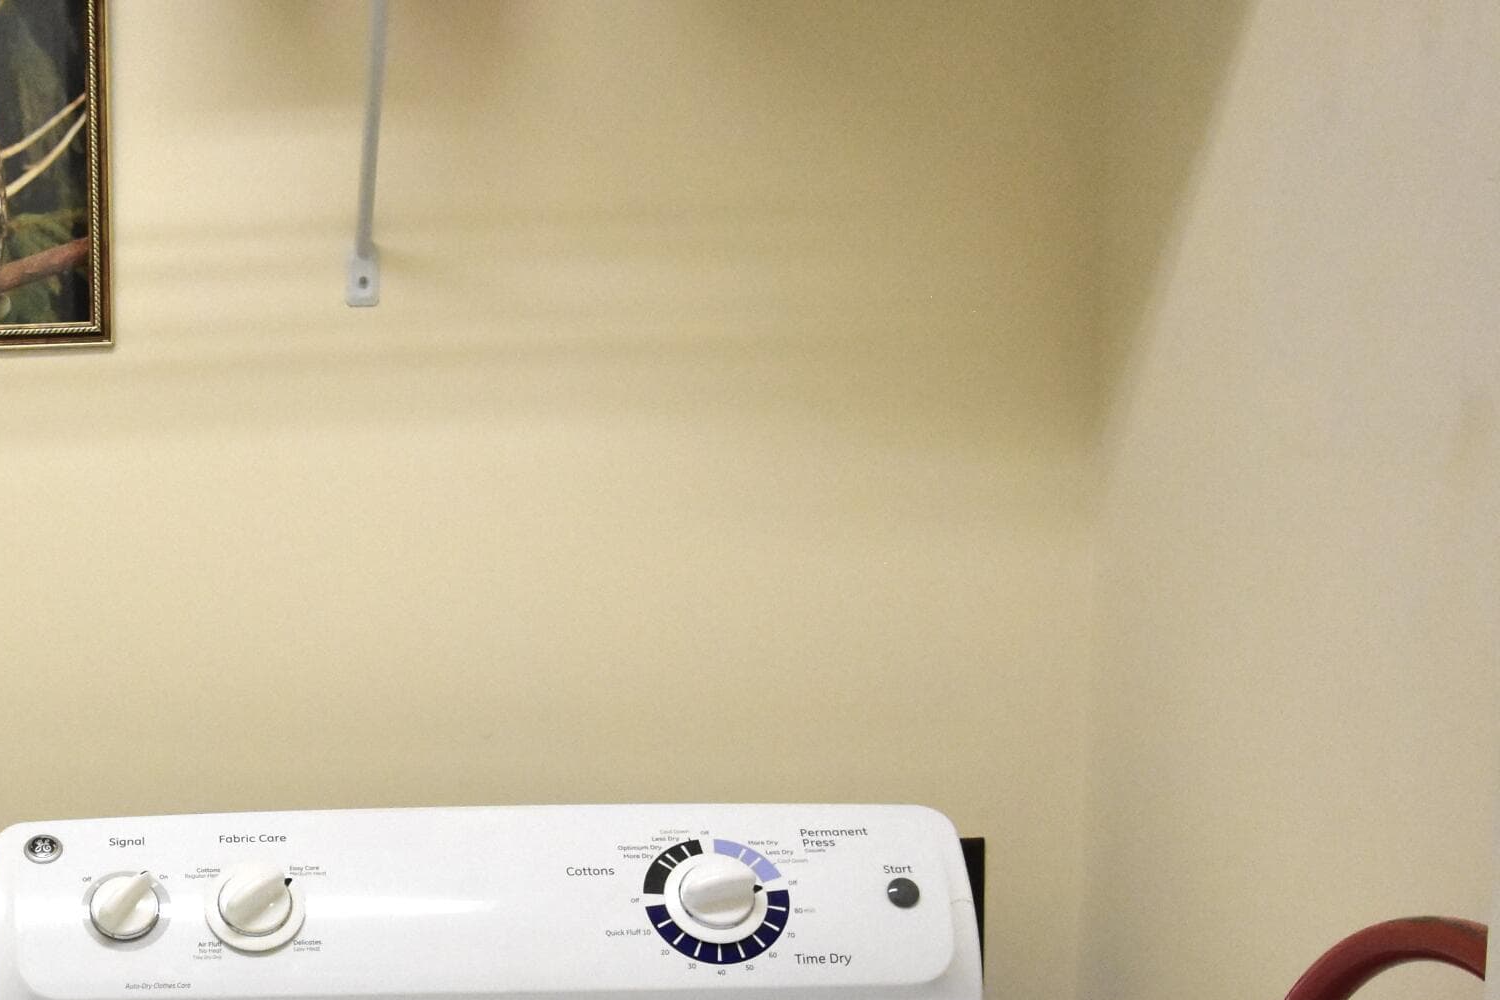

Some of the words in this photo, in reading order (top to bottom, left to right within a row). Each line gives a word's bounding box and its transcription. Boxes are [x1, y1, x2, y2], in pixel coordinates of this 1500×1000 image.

[800, 828, 868, 837] Permanent
[109, 837, 145, 848] Signal
[219, 834, 256, 843] Fabric
[258, 834, 287, 843] Care
[802, 838, 835, 847] Press
[566, 866, 615, 876] Cottons
[883, 865, 912, 874] Start
[606, 929, 624, 937] Quick
[795, 953, 826, 964] Time
[829, 953, 851, 965] Dry
